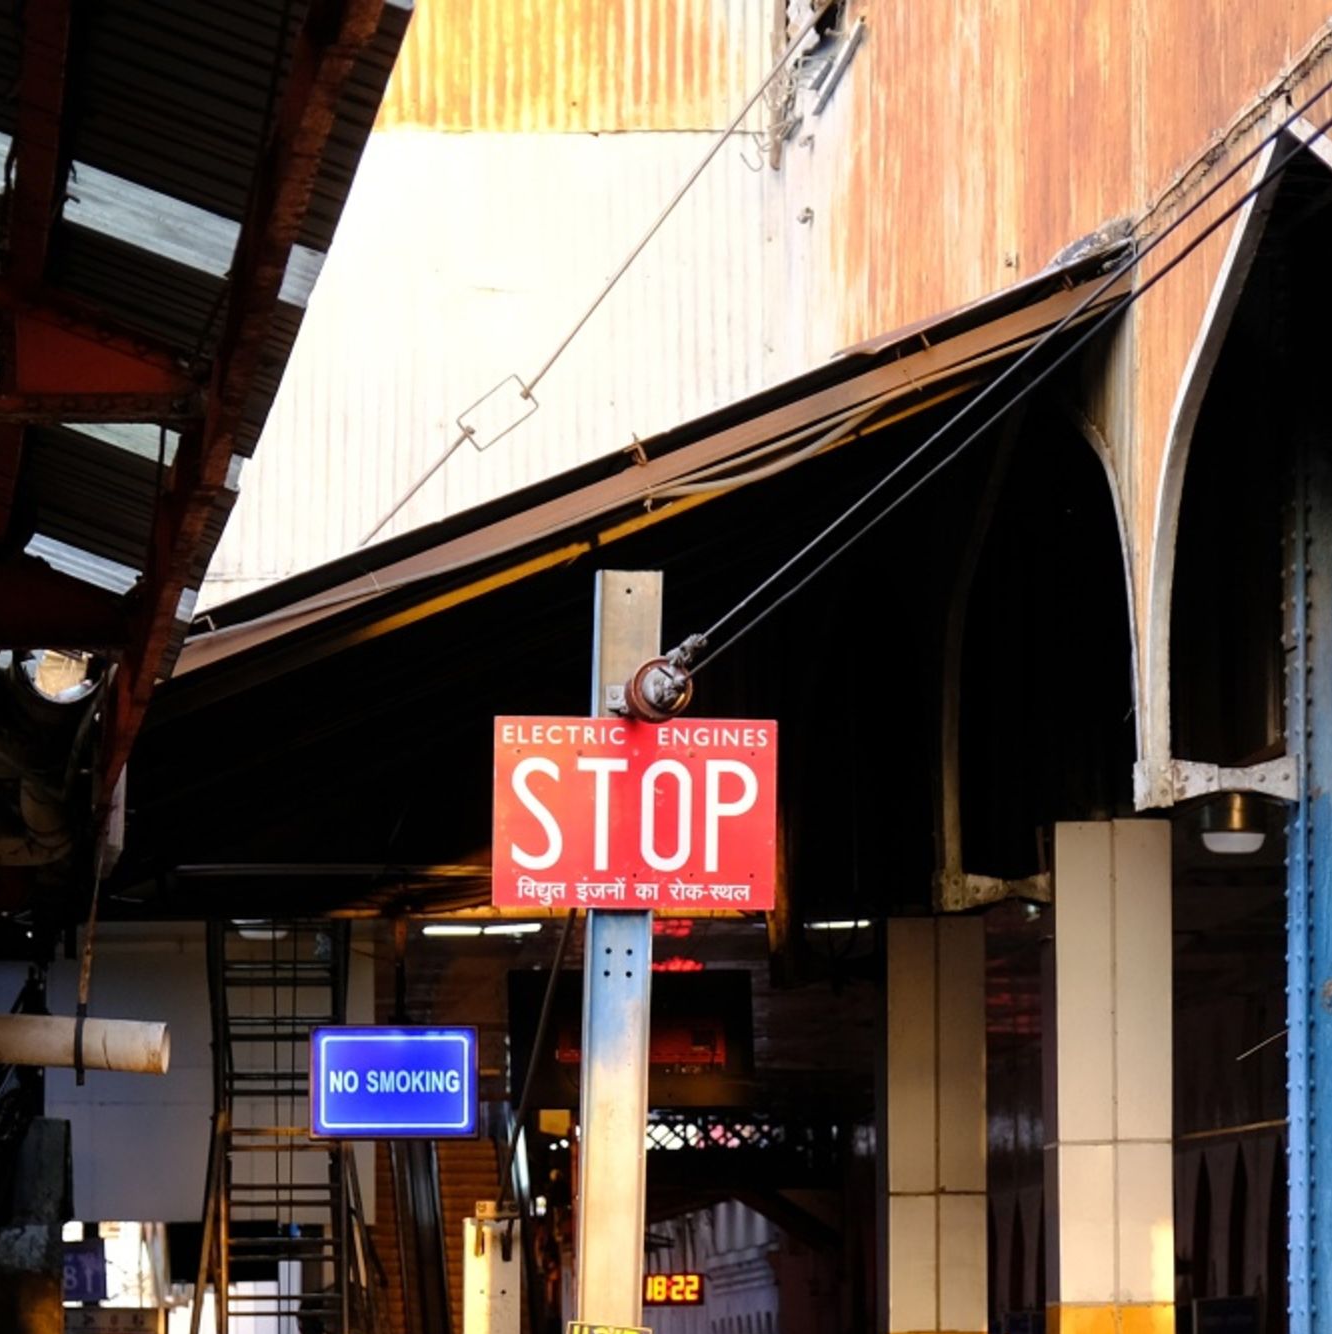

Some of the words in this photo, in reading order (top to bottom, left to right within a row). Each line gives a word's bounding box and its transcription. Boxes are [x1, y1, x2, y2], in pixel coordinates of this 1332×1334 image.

[502, 724, 627, 746] ELECTRIC
[657, 727, 769, 748] ENGINES
[510, 756, 759, 873] STOP
[517, 875, 567, 905] विद्युत
[575, 876, 626, 902] इंजनों
[634, 882, 660, 901] का
[329, 1070, 359, 1093] NO
[366, 1069, 461, 1093] SMOKING
[645, 1274, 700, 1302] 18:22
